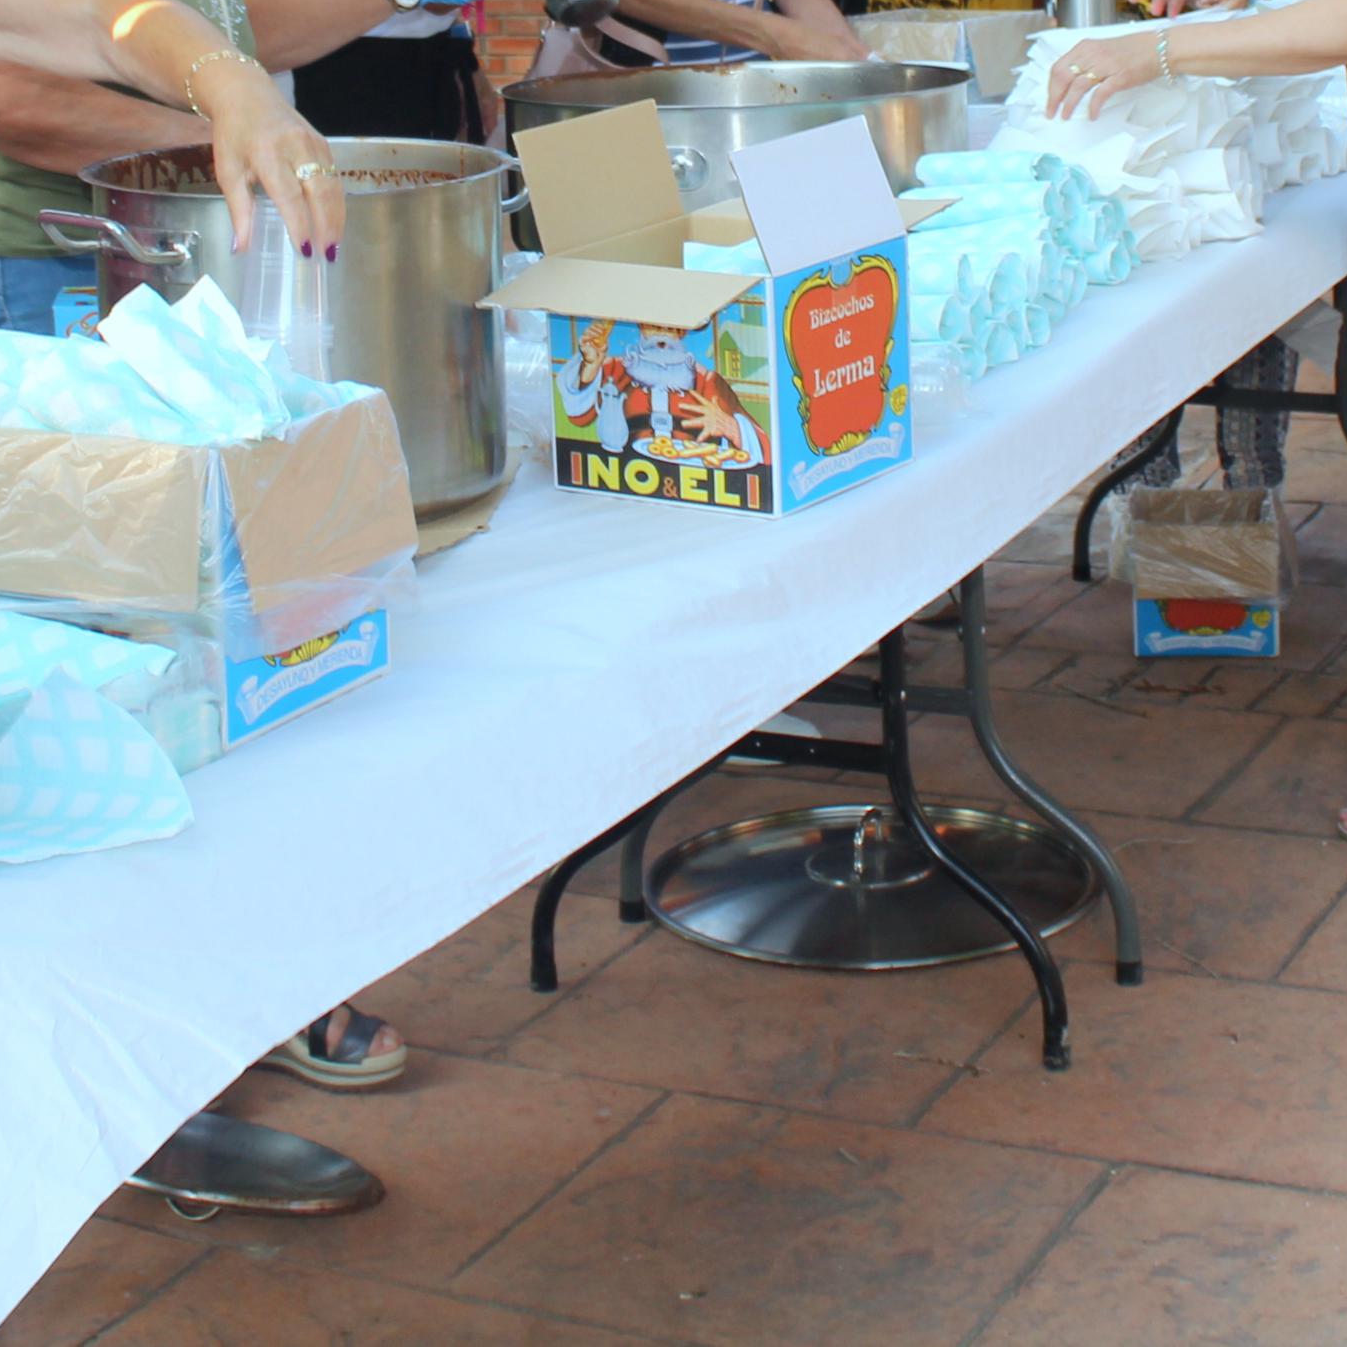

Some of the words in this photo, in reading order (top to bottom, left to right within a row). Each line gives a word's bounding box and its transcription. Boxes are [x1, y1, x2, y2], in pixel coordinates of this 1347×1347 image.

[808, 293, 875, 330] Bizcochos
[834, 328, 852, 349] de
[812, 354, 876, 398] Lerma
